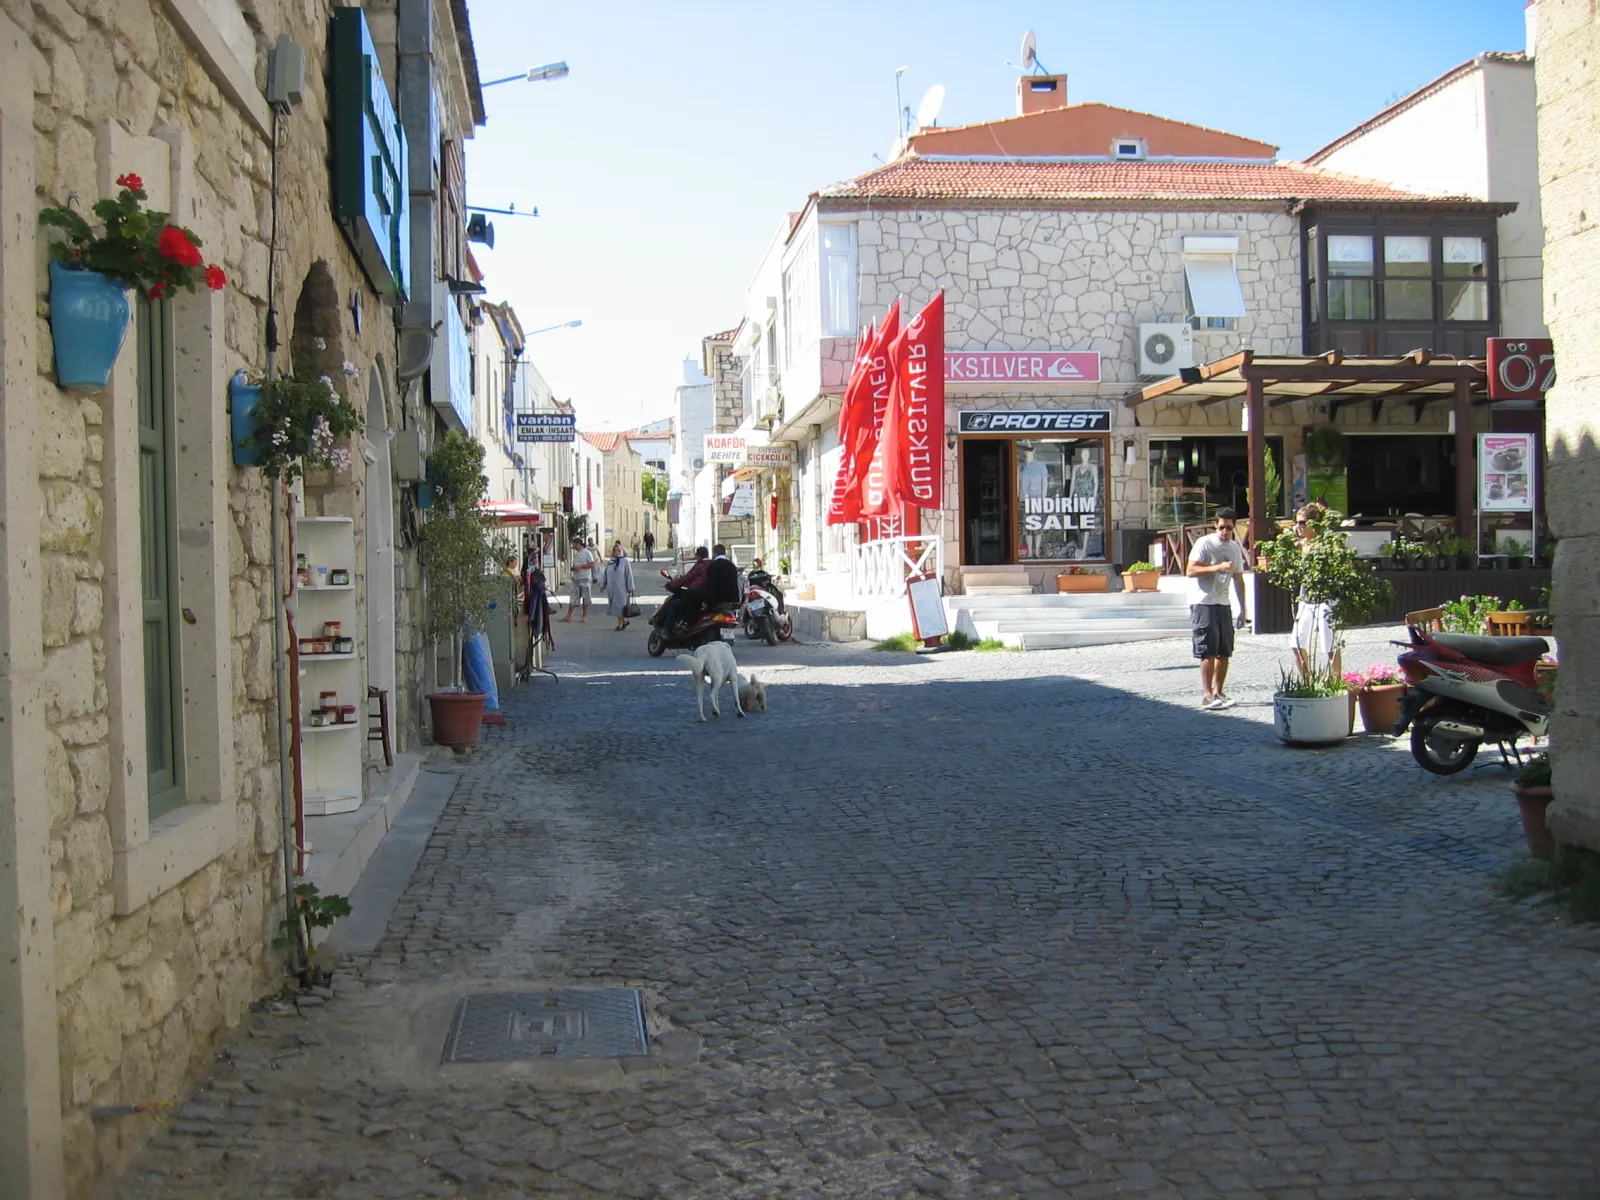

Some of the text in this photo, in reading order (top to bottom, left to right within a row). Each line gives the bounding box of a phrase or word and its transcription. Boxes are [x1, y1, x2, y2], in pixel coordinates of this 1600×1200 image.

[519, 415, 571, 425] varhan
[990, 414, 1103, 429] PROTEST
[1024, 493, 1095, 513] İNDİRİM
[1025, 514, 1095, 530] SALE
